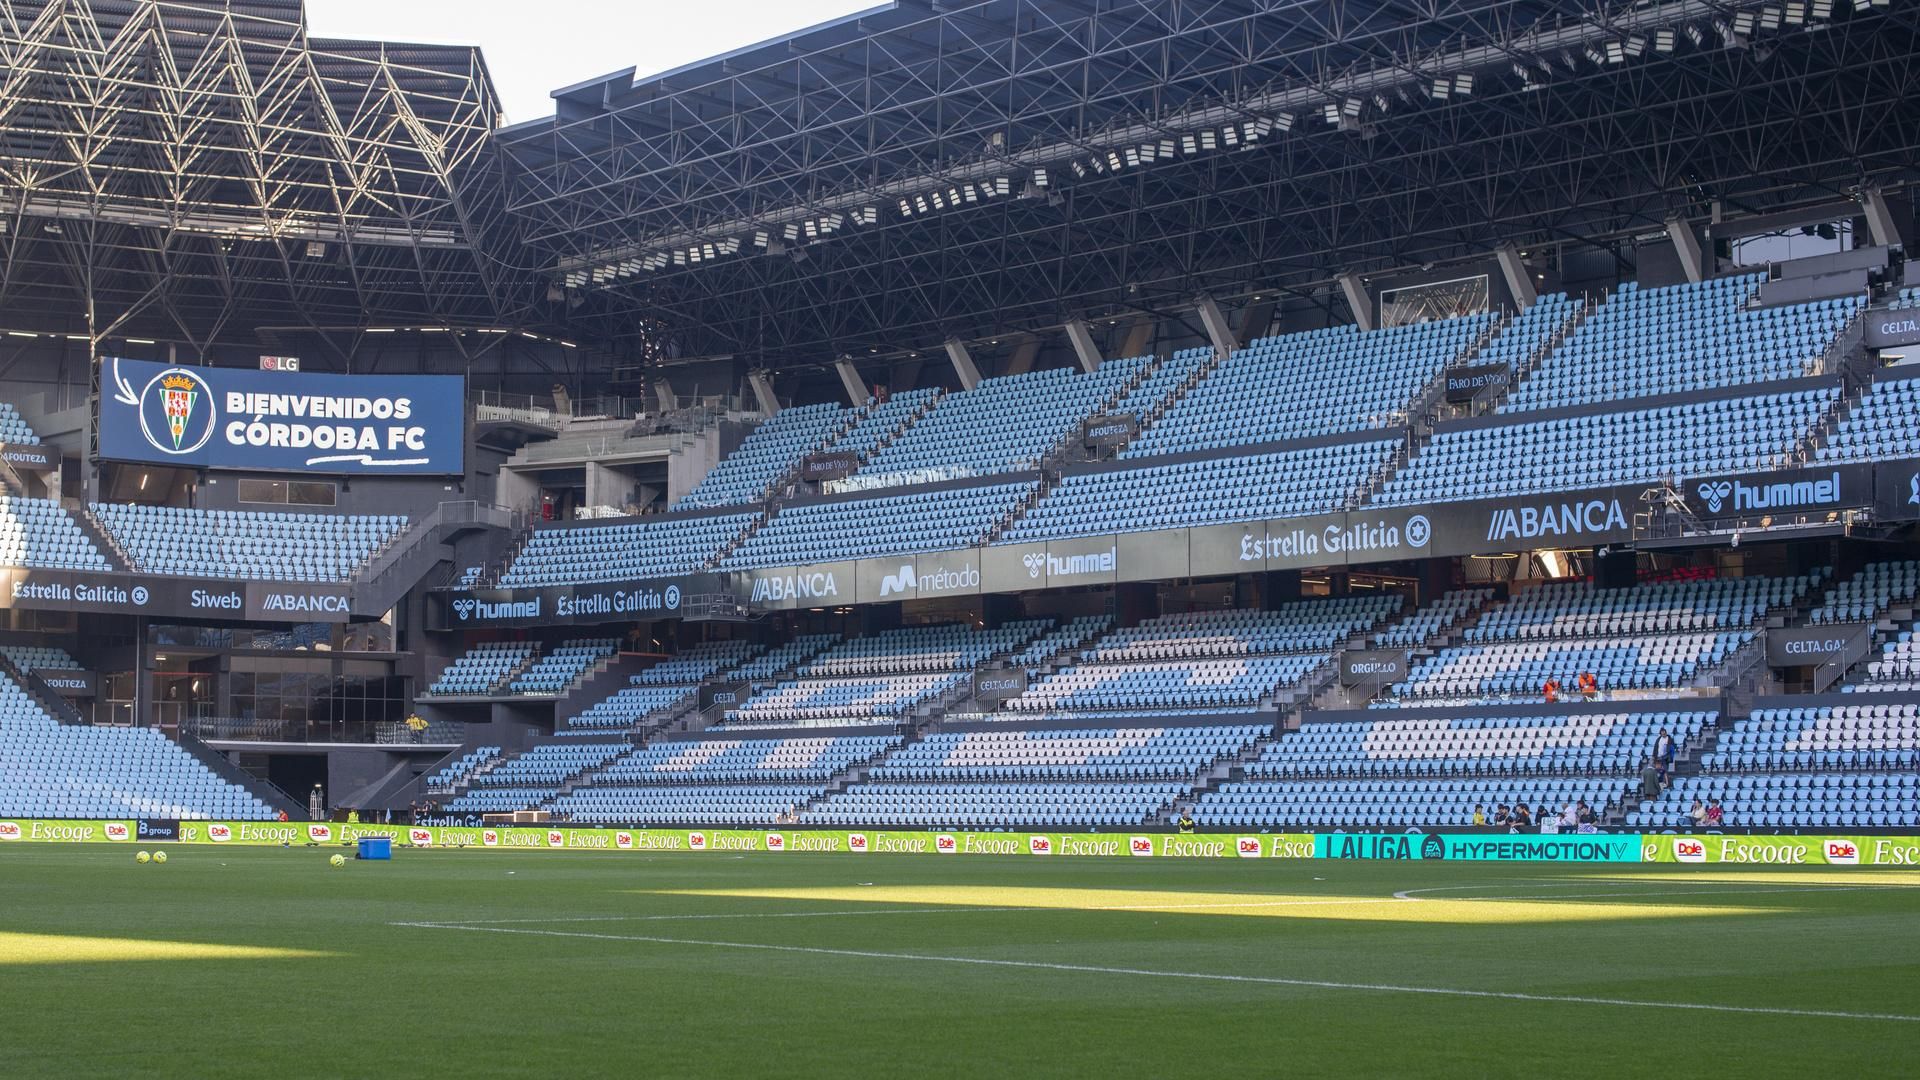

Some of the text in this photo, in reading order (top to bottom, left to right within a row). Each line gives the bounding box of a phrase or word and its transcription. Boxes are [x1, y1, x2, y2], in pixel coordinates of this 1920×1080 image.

[277, 357, 297, 370] LG
[1449, 378, 1470, 390] FARO
[1472, 376, 1484, 387] DE
[226, 391, 411, 419] BIENVENIDOS
[226, 415, 425, 450] CÓRDOBA FC
[1735, 471, 1840, 510] hummel
[1239, 520, 1400, 561] Estrella Galicia
[1047, 547, 1117, 576] hummel
[919, 563, 980, 592] método
[12, 581, 127, 603] Estrella Galicia
[191, 589, 241, 609] Siweb
[476, 597, 540, 619] hummel
[556, 589, 661, 616] Estrella Galicia
[44, 679, 86, 688] FOUTEZA
[32, 822, 93, 841] Escoge
[108, 826, 126, 834] Dole
[149, 828, 172, 836] group
[211, 827, 229, 835] Dole
[240, 824, 297, 842] Escoge
[312, 827, 328, 835] Dole
[413, 831, 430, 839] Dole
[439, 829, 476, 845] Escoge
[503, 829, 541, 846] Escoge
[569, 831, 609, 848] Escoge
[639, 832, 681, 848] Escoge
[713, 832, 758, 849] Escoge
[792, 834, 839, 850] Escoge
[851, 836, 866, 845] Dole
[875, 834, 926, 852] Escoge
[939, 838, 954, 847] Dole
[965, 835, 1019, 853] Escoge
[1033, 839, 1048, 848] Dole
[1060, 836, 1119, 855] Escoge
[1133, 840, 1150, 850] Dole
[1162, 837, 1225, 856] Escoge
[1241, 841, 1258, 850] Dole
[1272, 837, 1315, 857] Esco
[1326, 836, 1411, 859] LALIGA
[1678, 842, 1702, 854] Dole
[1720, 839, 1806, 863] Escoge
[1829, 844, 1855, 856] Dole
